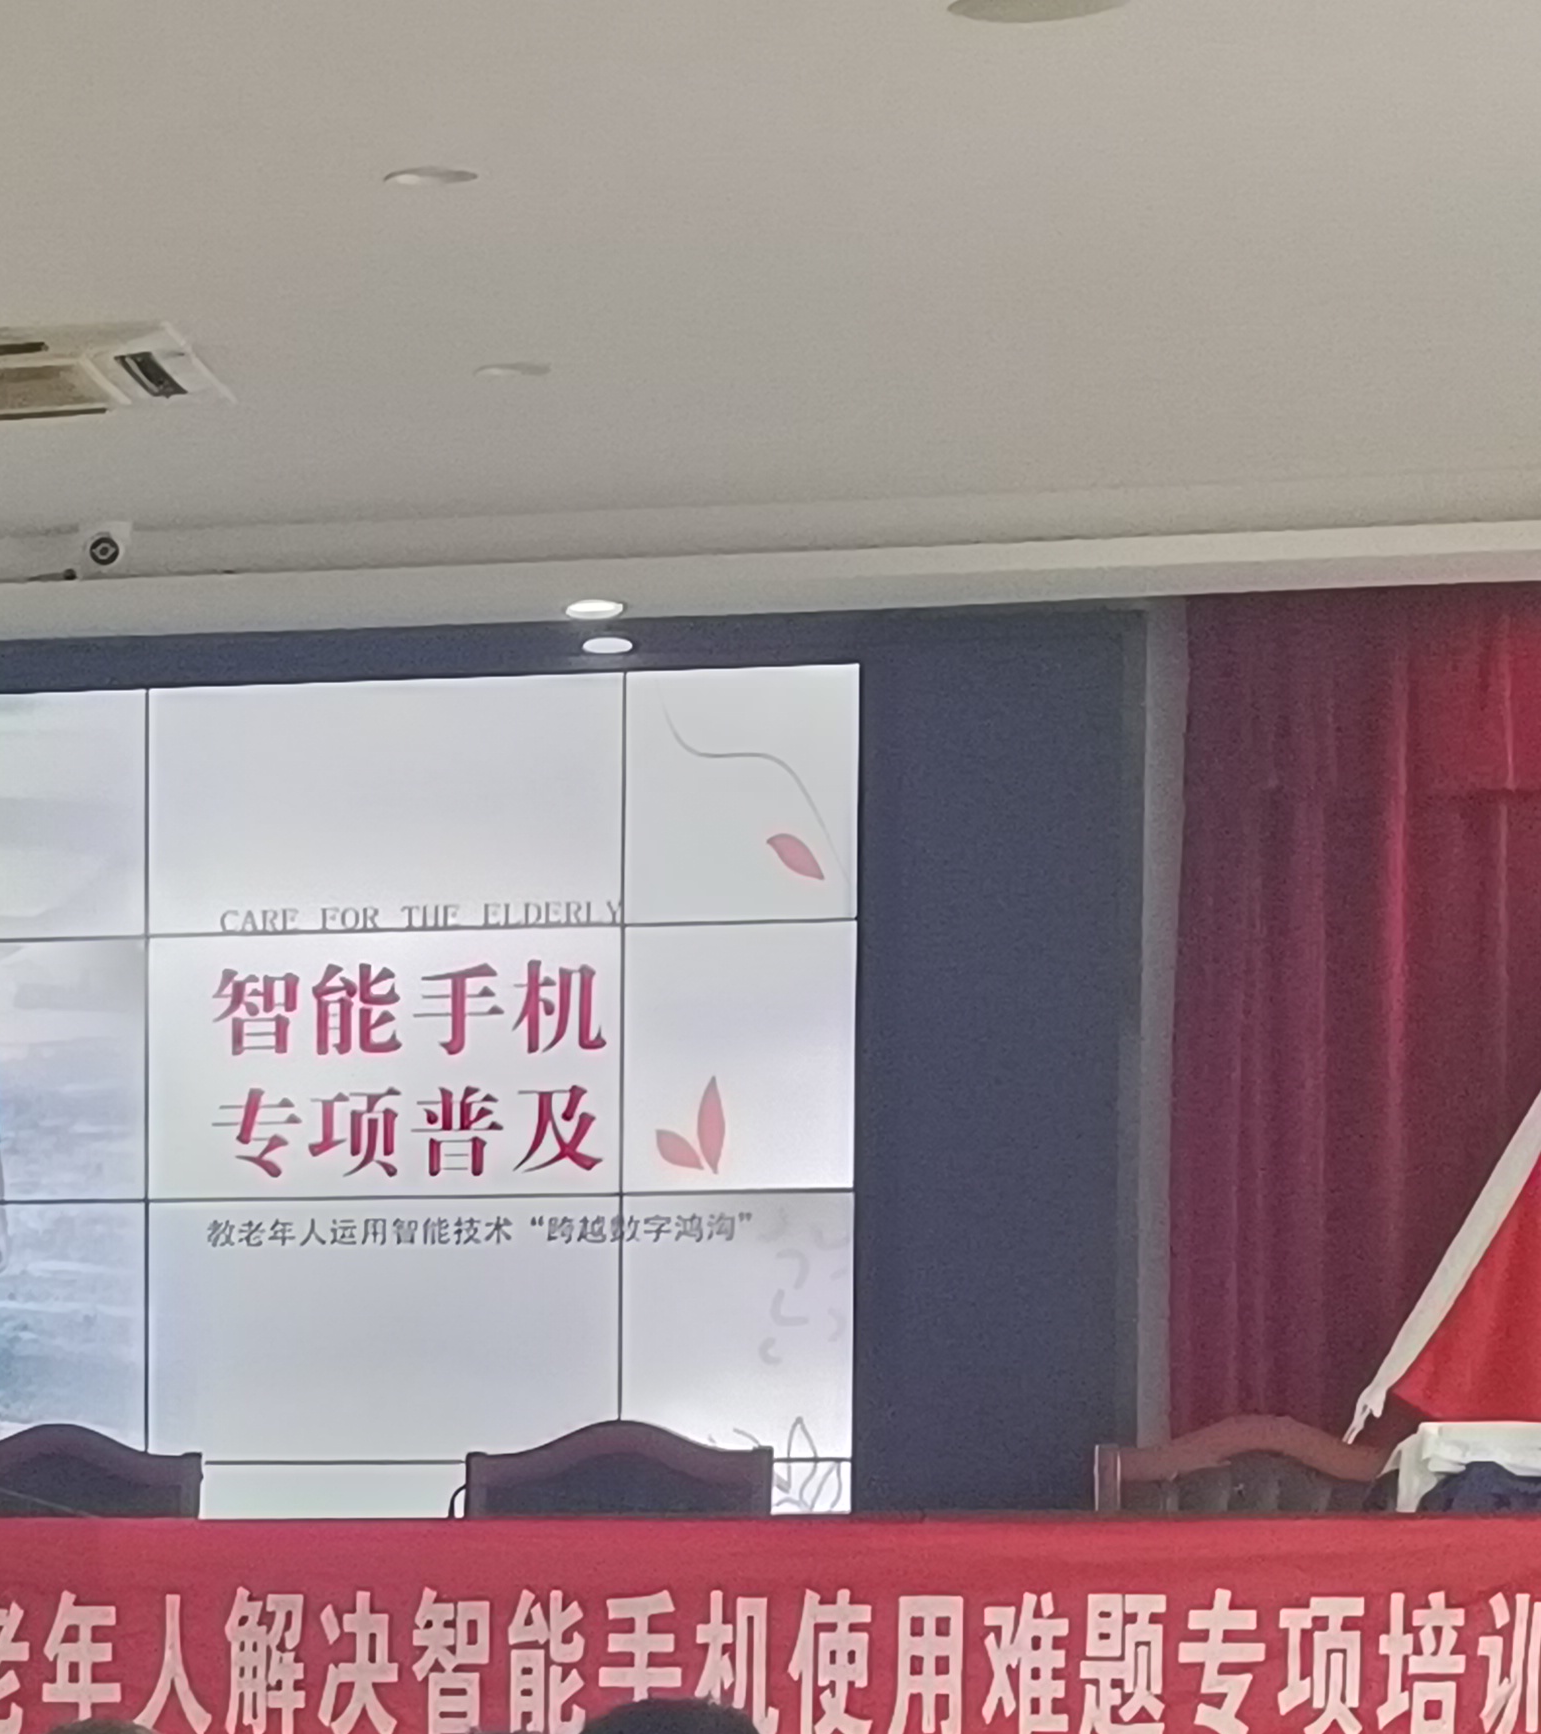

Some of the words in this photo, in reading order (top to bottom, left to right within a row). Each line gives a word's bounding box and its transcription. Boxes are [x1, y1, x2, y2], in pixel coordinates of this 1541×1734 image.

[220, 908, 299, 932] CARE
[321, 906, 380, 930] FOR
[401, 903, 460, 929] THE
[483, 900, 624, 927] ELDERLY
[212, 958, 608, 1056] 智能手机
[212, 1084, 605, 1178] 专项普及
